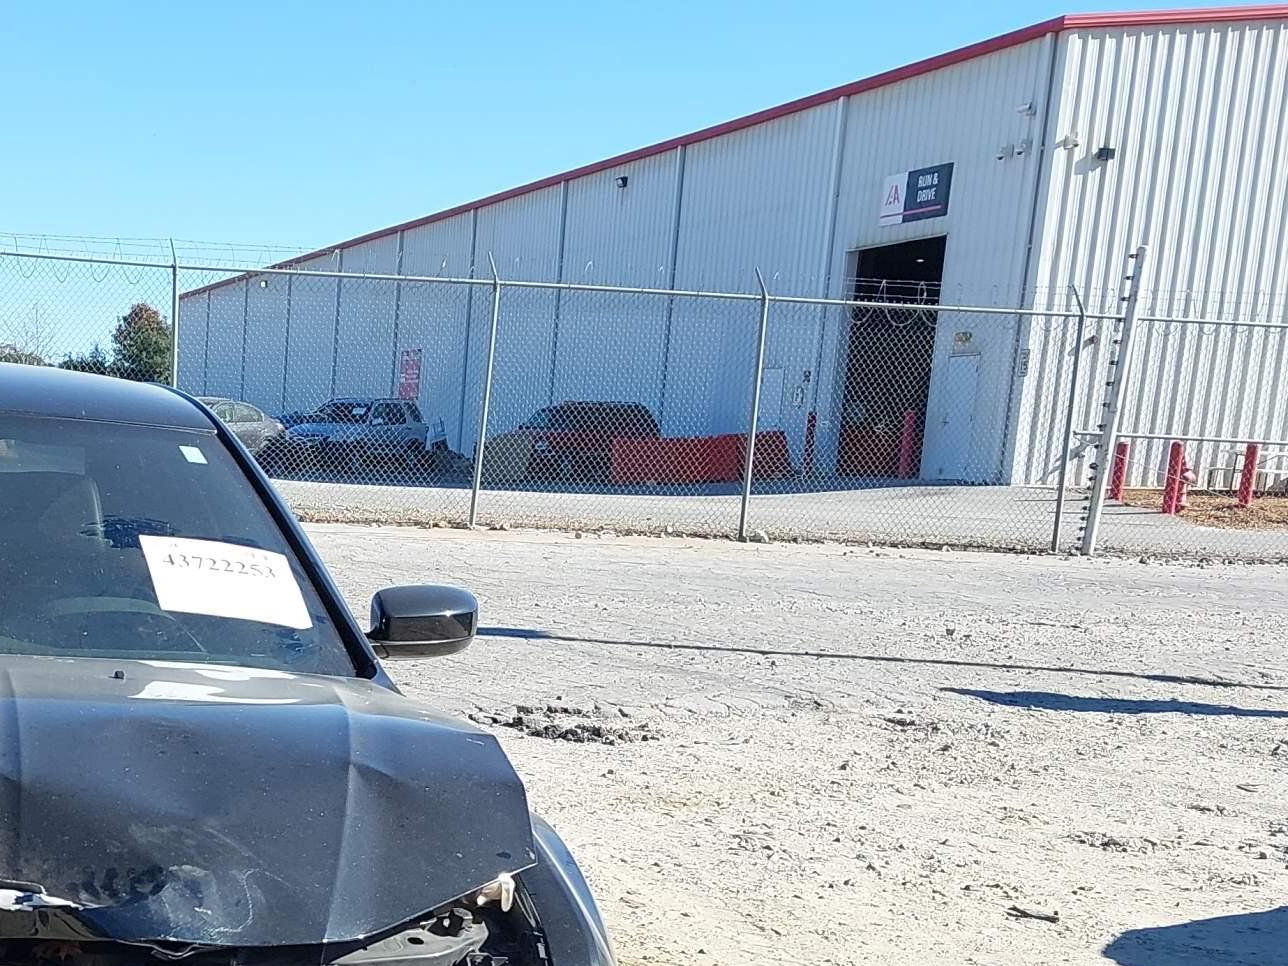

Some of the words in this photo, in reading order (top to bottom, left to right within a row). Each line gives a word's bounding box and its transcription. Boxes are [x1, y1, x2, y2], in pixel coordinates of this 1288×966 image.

[918, 173, 932, 188] RUN
[932, 172, 939, 185] &
[917, 187, 936, 203] DRIVE
[162, 553, 277, 579] 43722253
